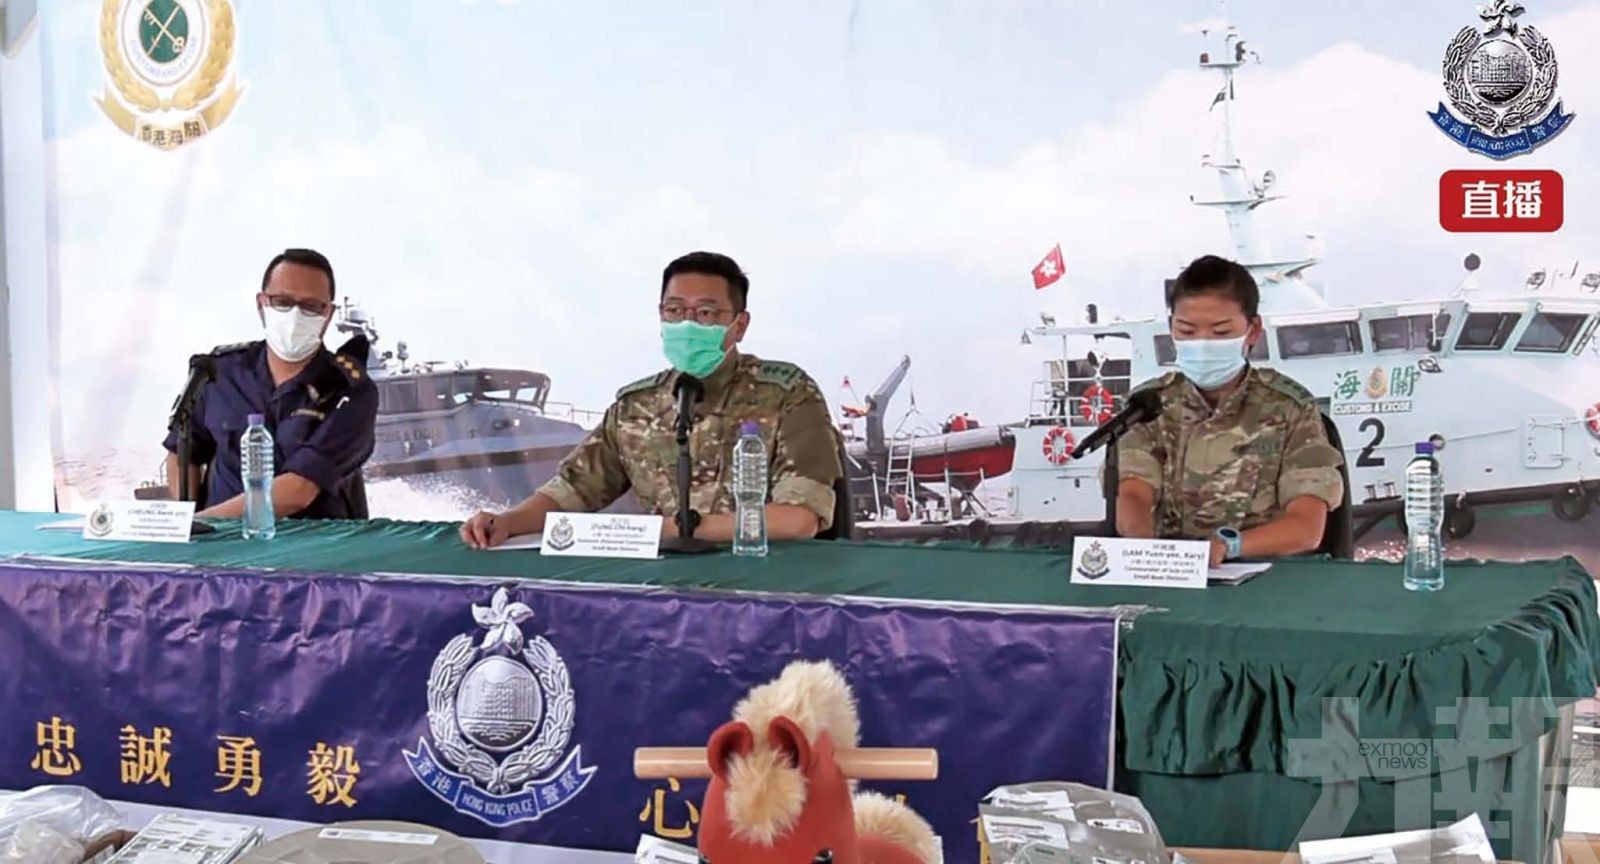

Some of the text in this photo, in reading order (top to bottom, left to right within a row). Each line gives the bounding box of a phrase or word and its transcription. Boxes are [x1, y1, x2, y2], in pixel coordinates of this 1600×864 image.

[1356, 417, 1386, 468] 2
[461, 792, 534, 817] HONG KONG POLICE
